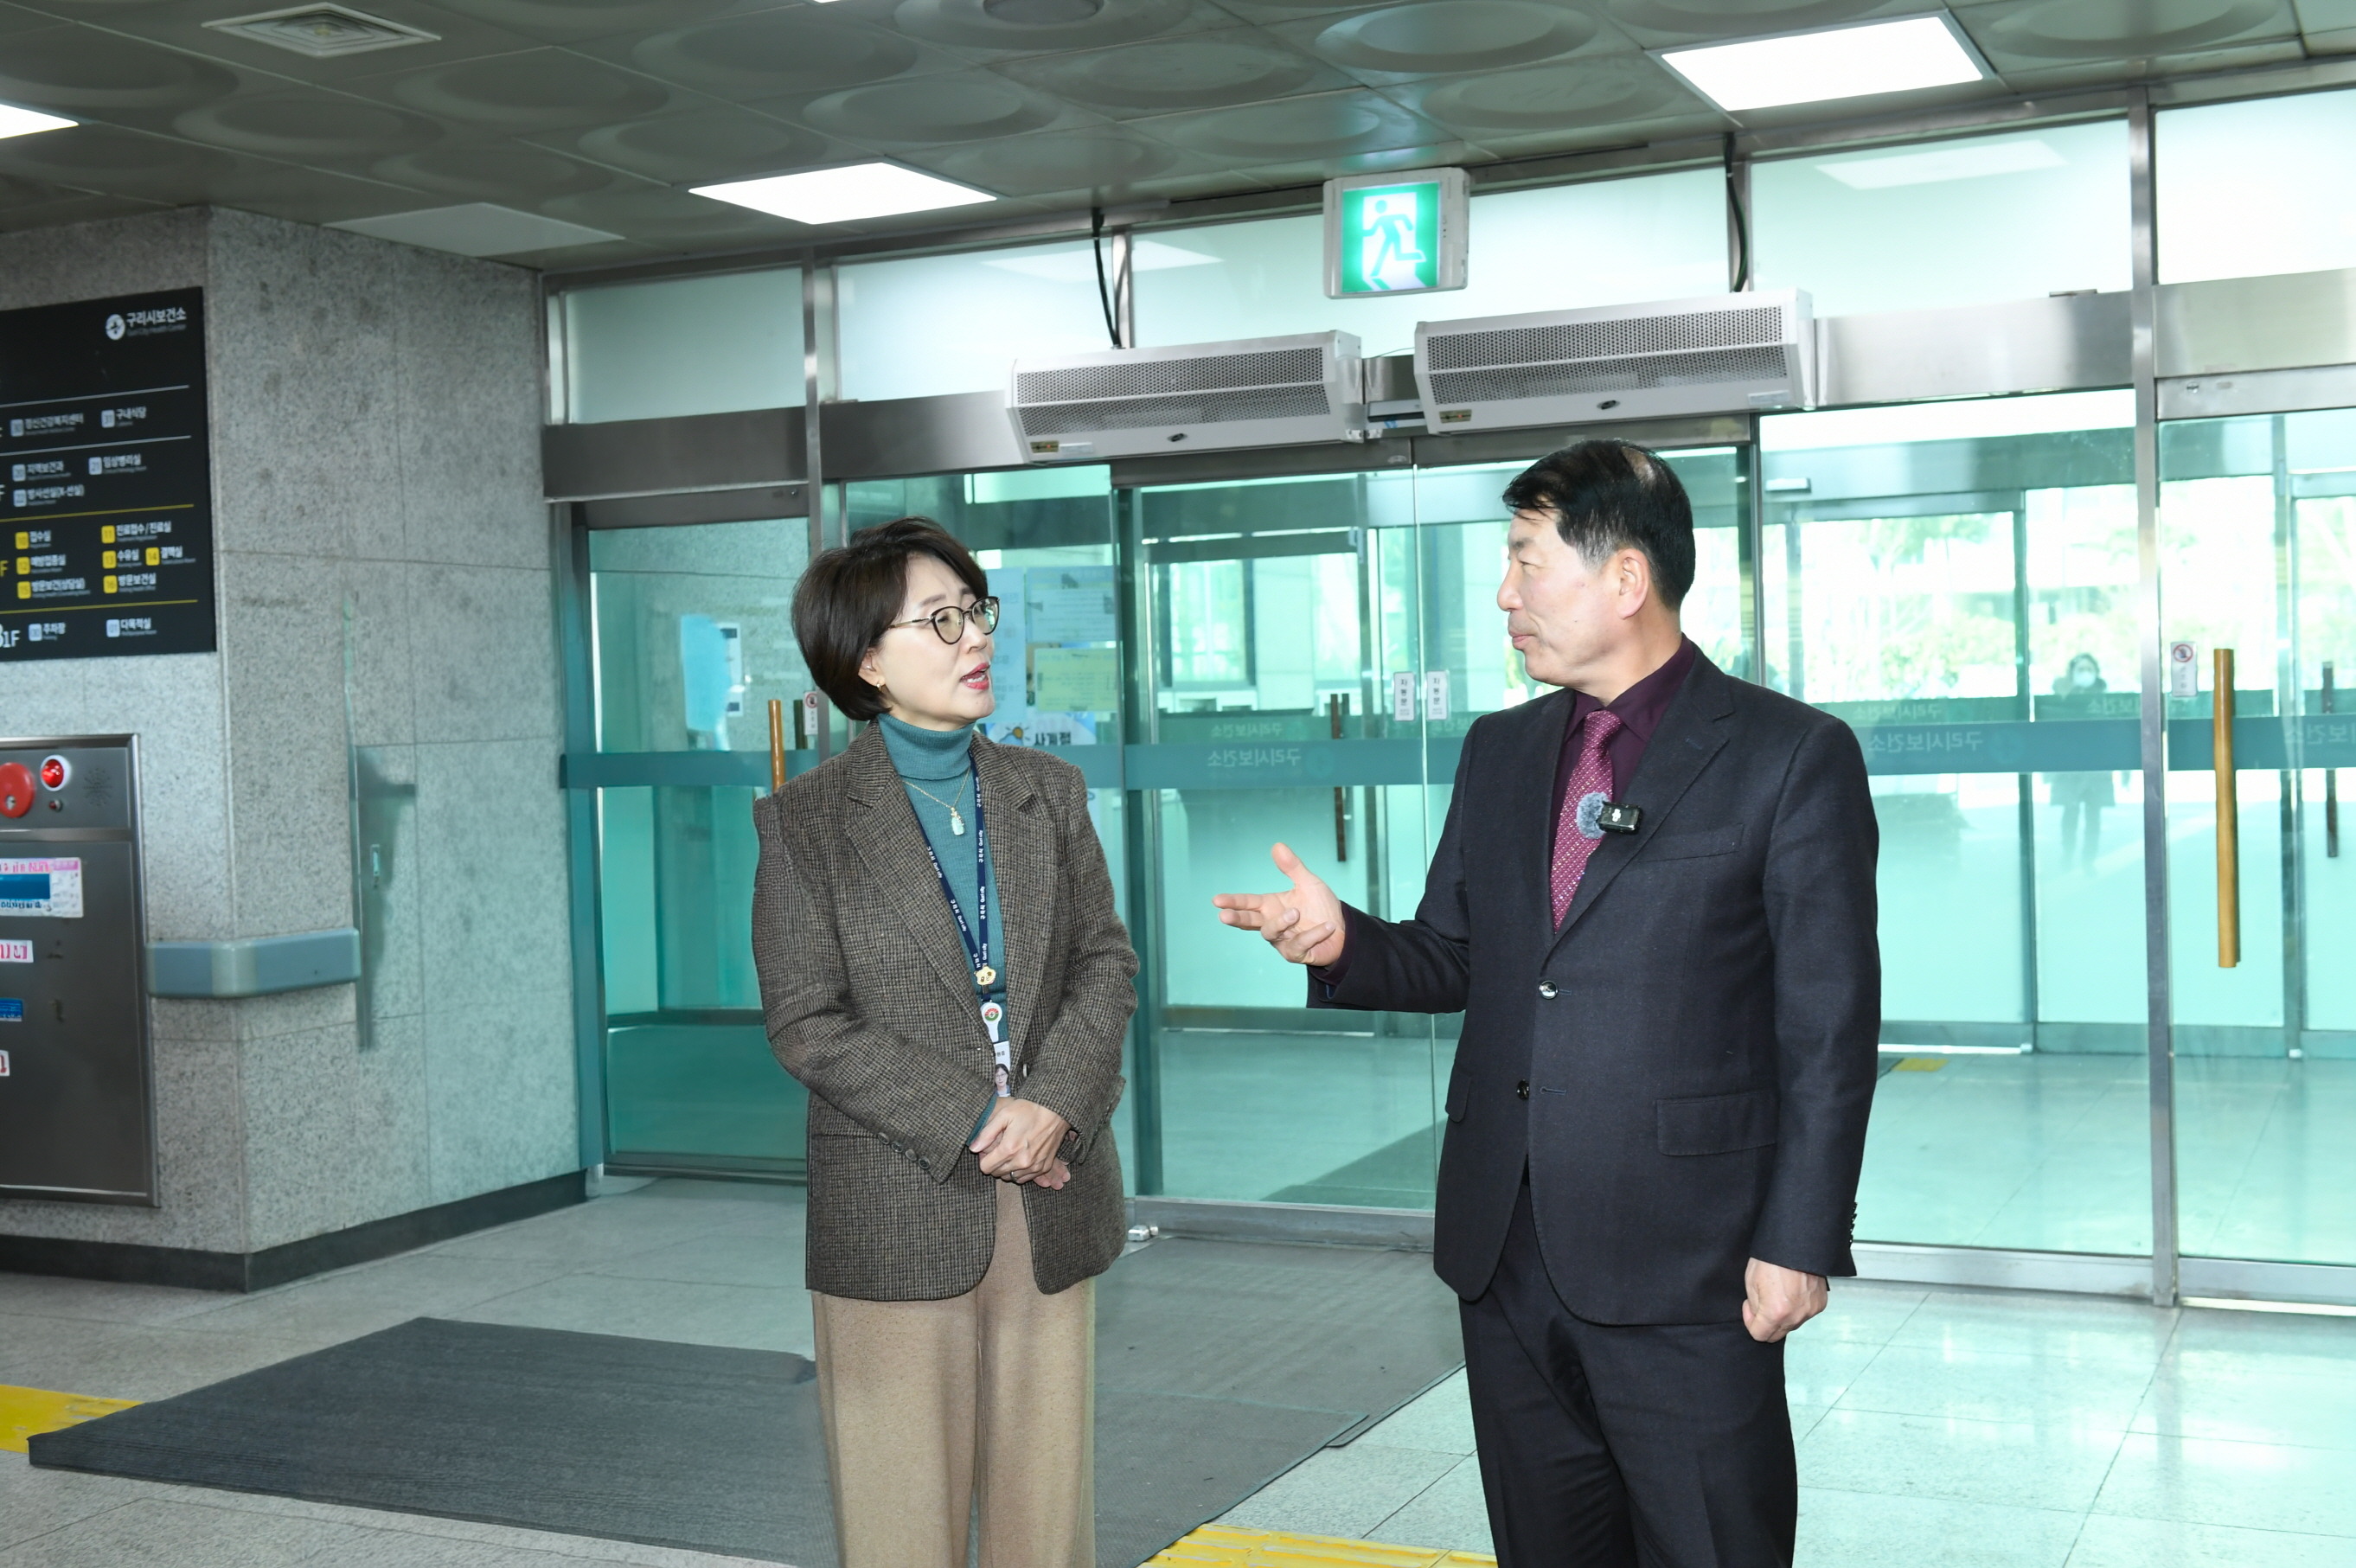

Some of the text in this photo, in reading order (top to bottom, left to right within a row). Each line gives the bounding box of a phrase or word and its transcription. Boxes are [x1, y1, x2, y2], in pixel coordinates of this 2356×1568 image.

[126, 307, 187, 328] 구리시보건소
[116, 406, 146, 420] 구내식당
[1399, 678, 1408, 707] 자동문
[1432, 677, 1441, 706] 자동문
